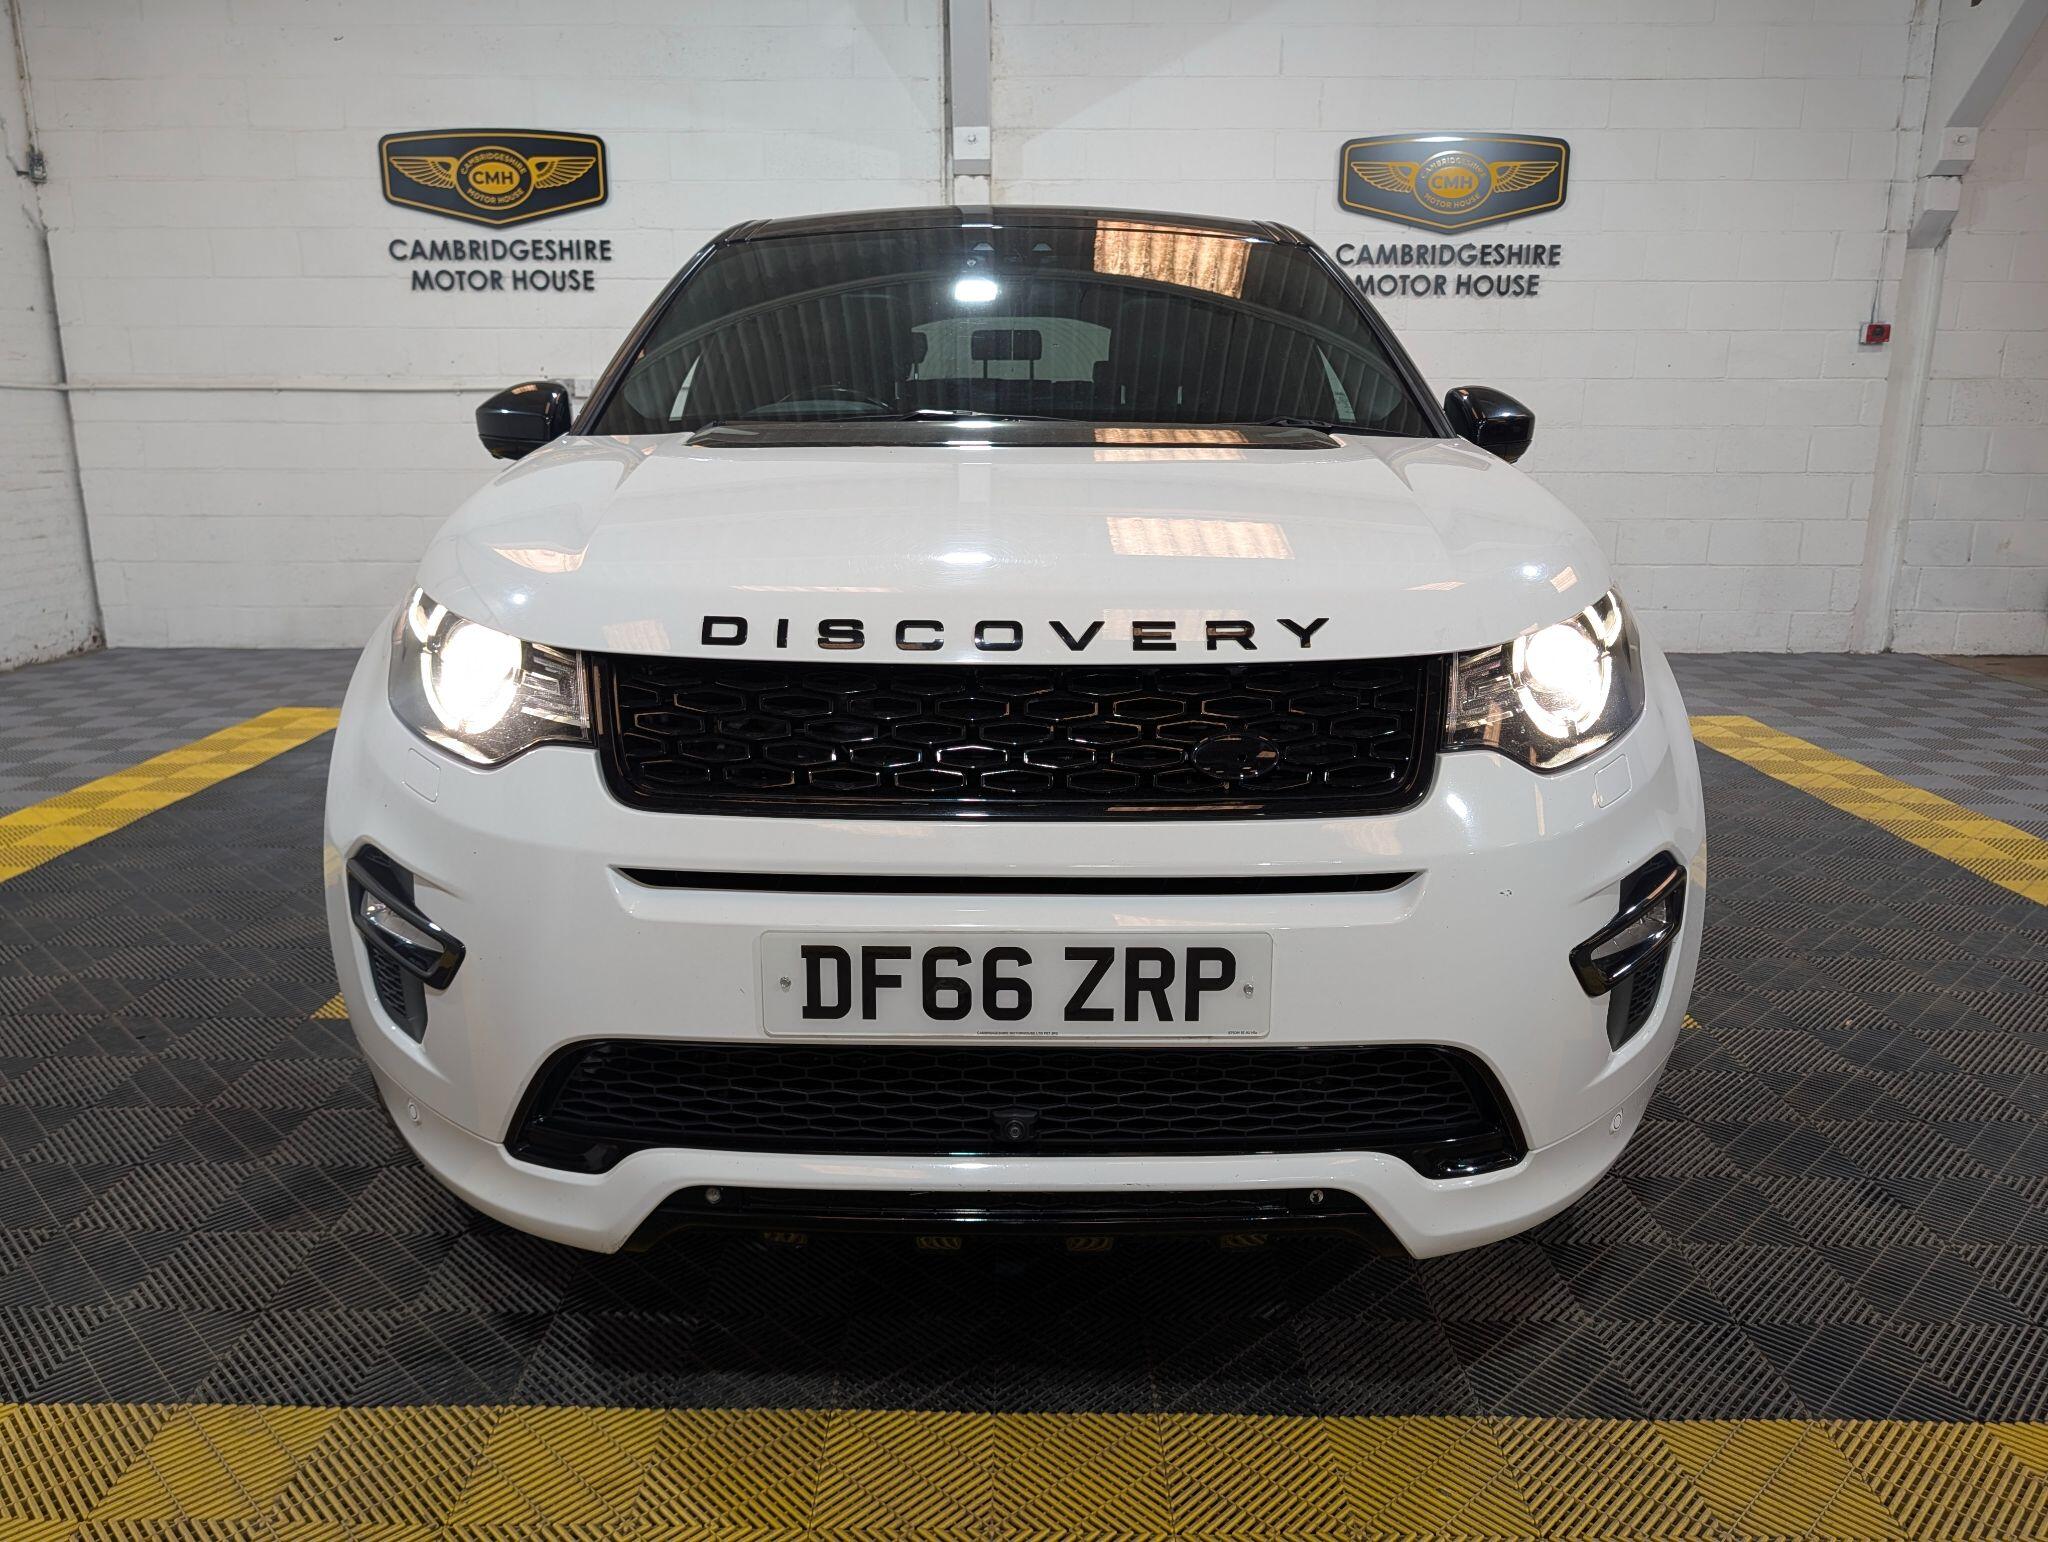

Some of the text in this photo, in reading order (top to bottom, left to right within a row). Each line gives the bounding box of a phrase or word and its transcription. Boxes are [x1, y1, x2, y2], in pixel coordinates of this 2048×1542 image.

[460, 151, 527, 175] CAMBRIDGESHIRE
[1421, 156, 1488, 179] AMBRIDGHIRE
[473, 171, 514, 185] CMH
[1431, 174, 1473, 189] CMH
[466, 187, 525, 204] MOTOR HOUSE
[1424, 192, 1480, 208] MOTOR HOUSE
[389, 239, 611, 262] CAMBRIDGESHIRE
[1336, 243, 1562, 266] CAMBRIDGESHIRE
[412, 269, 595, 292] MOTOR HOUSE
[1355, 274, 1540, 297] MOTOR HOUSE
[701, 614, 1331, 652] DISCOVERY
[801, 944, 1237, 1022] DF66 ZRP
